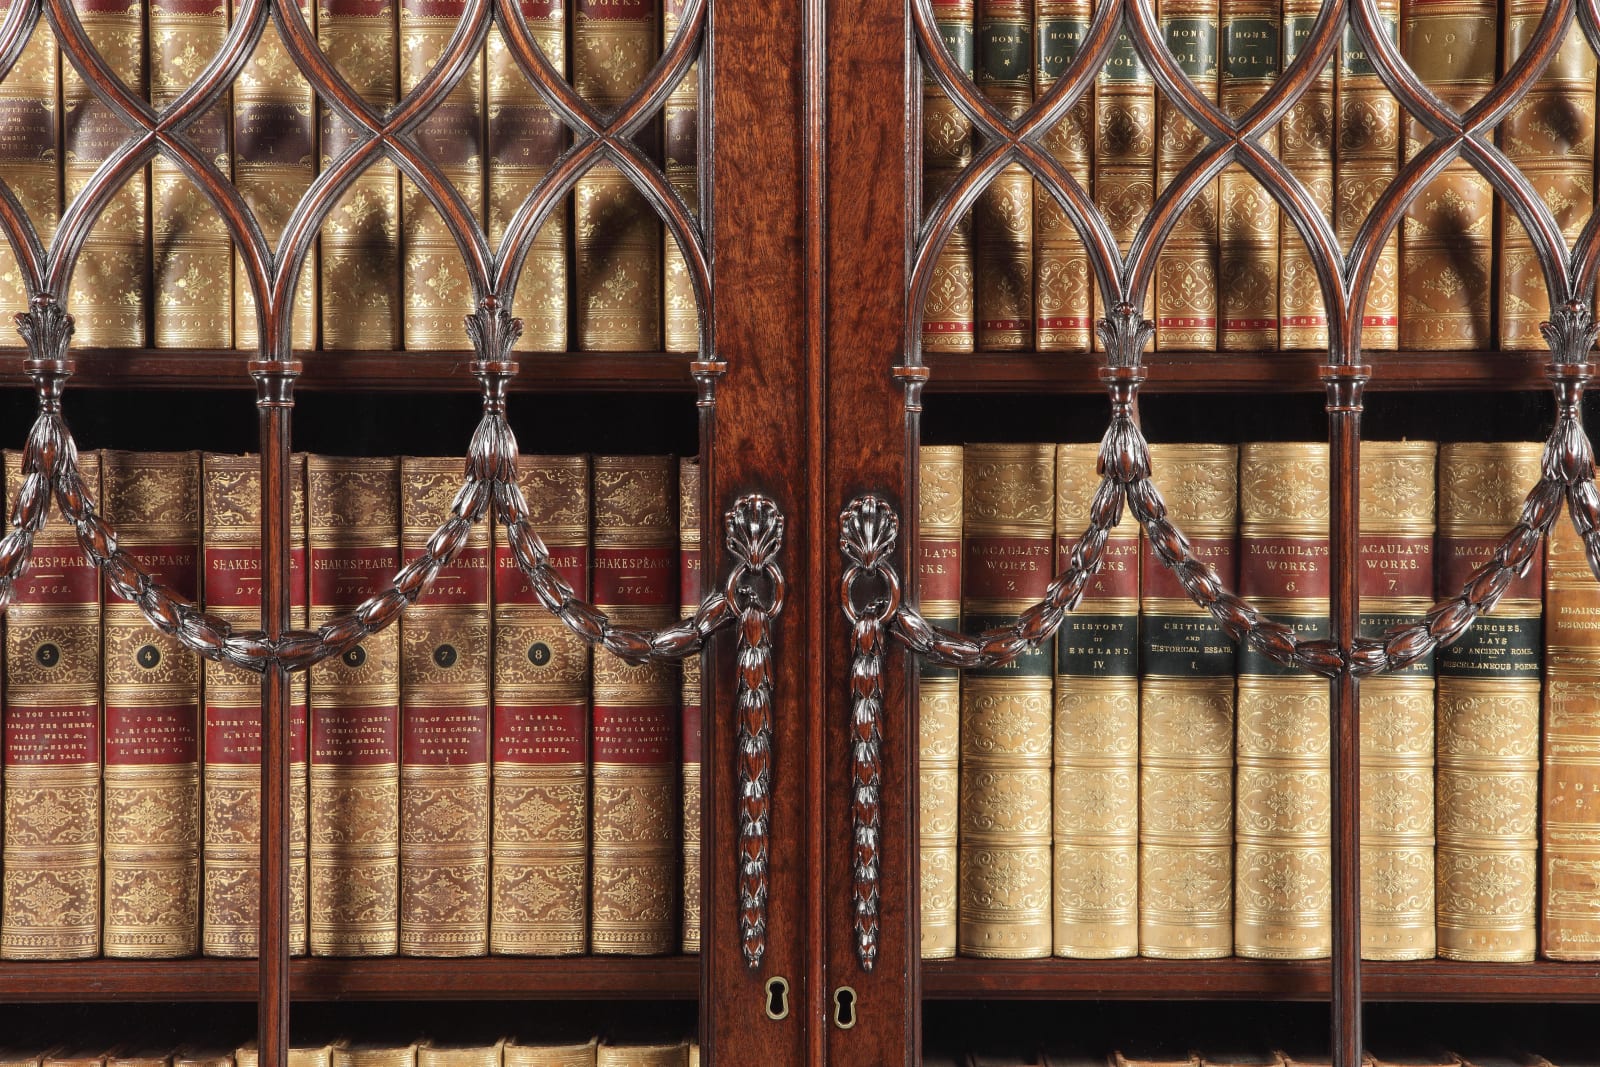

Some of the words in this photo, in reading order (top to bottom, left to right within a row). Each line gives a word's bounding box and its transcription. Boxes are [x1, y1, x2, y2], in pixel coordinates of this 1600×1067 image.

[1250, 544, 1329, 556] MACAULAY'S
[1361, 544, 1430, 554] ACAULAY'S
[1266, 560, 1318, 572] WORKS.
[1366, 559, 1420, 570] WORKS.
[1073, 623, 1124, 631] HISTORY
[1164, 623, 1220, 631] CRITICAL
[1479, 637, 1508, 646] LAYS
